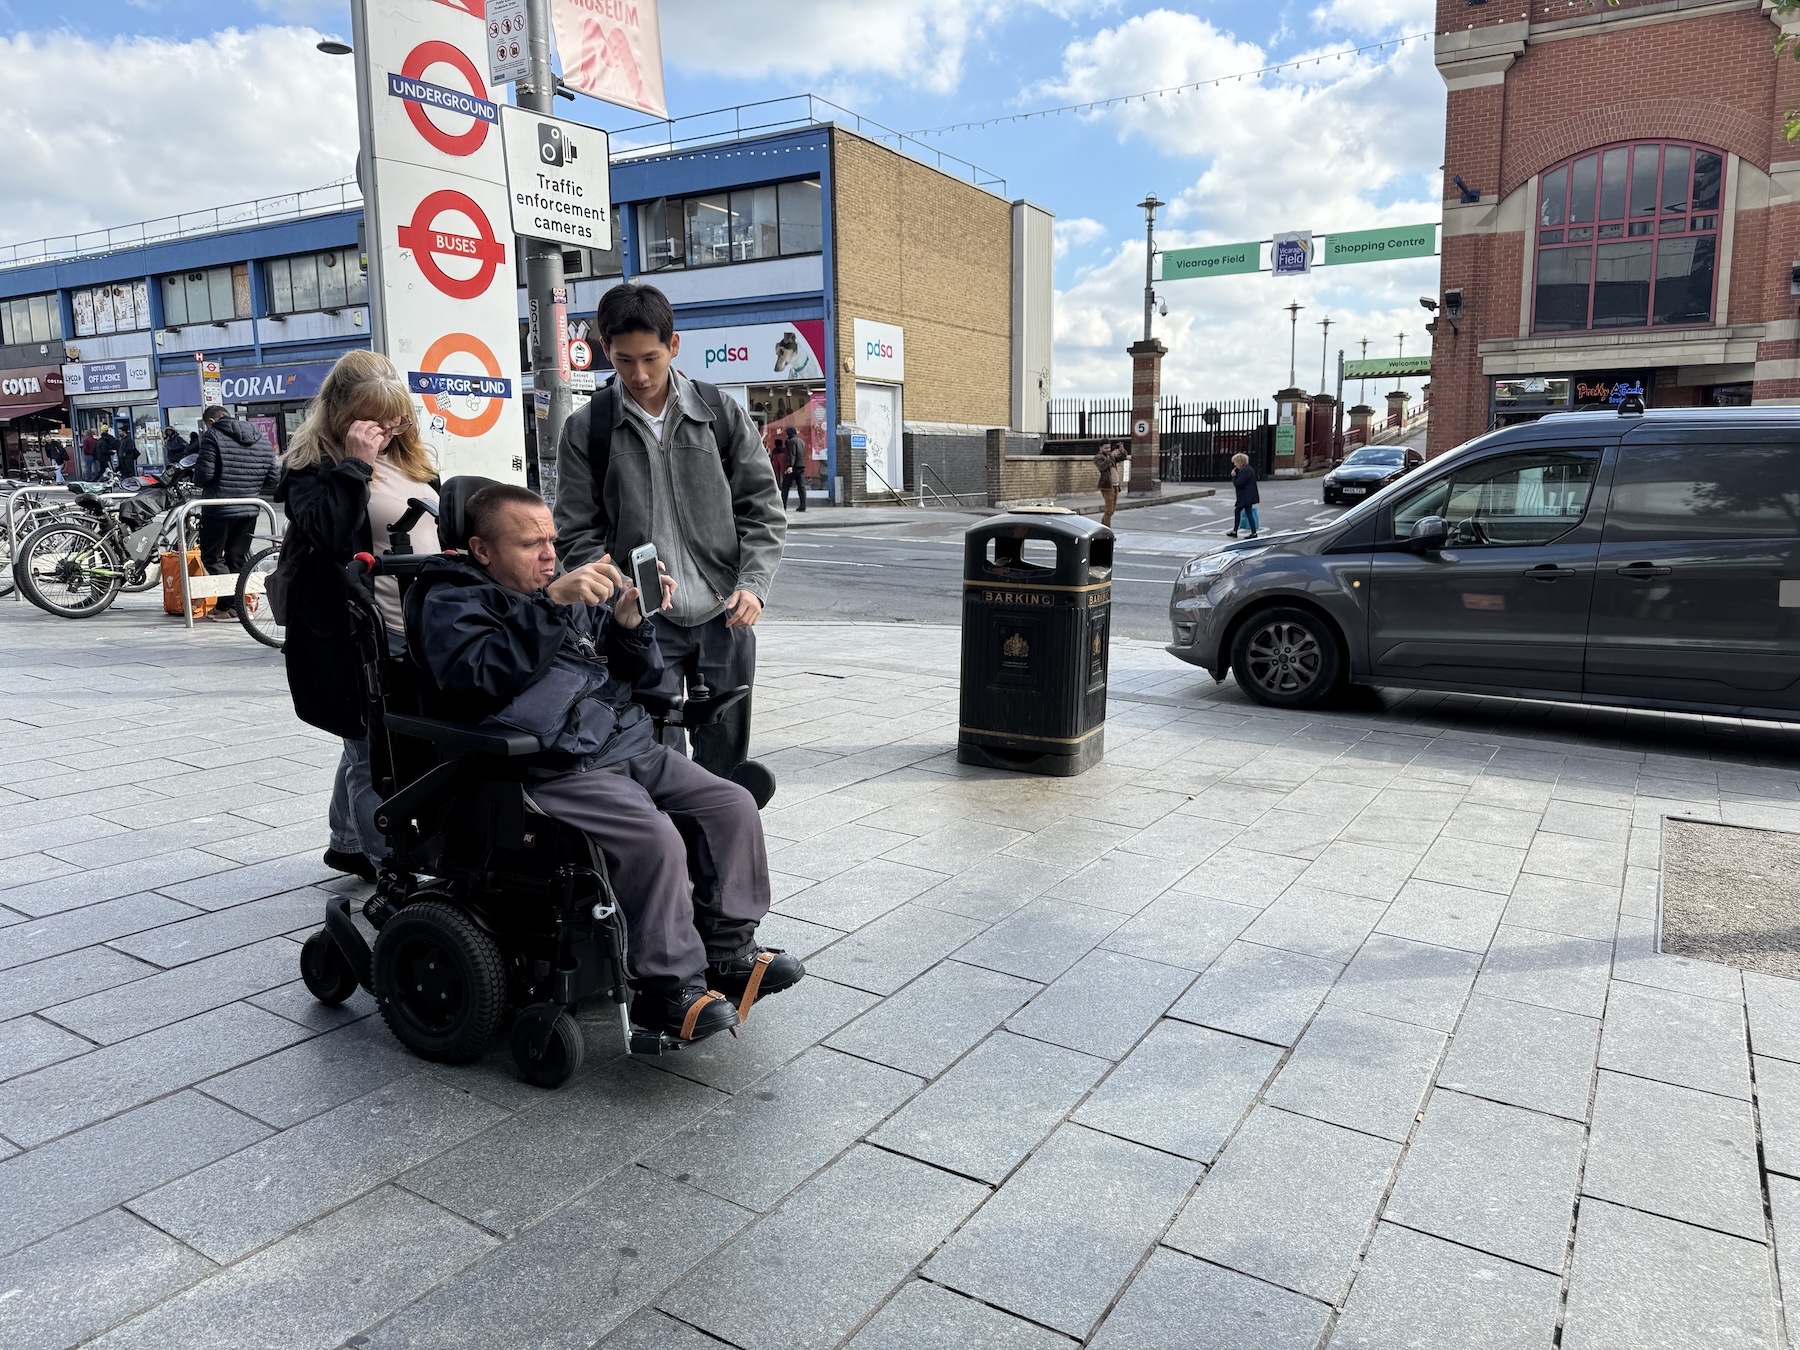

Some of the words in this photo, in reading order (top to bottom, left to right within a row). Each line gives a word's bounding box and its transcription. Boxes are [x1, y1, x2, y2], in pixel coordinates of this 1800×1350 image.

[392, 79, 495, 119] UNDERGROUND
[536, 172, 583, 197] Traffic
[516, 193, 606, 222] enforcement
[534, 216, 592, 238] cameras
[436, 234, 477, 254] BUSES
[1334, 241, 1385, 254] Shopping
[1387, 238, 1426, 248] Centre
[1176, 258, 1220, 269] Vicarage
[1222, 254, 1245, 264] Field
[1279, 252, 1304, 265] Field
[705, 343, 749, 369] pdsa
[866, 339, 893, 360] pdsa
[2, 377, 42, 397] COSTA
[88, 374, 99, 384] OFF
[99, 373, 121, 383] LICENCE
[221, 374, 287, 398] CORAL
[419, 377, 506, 394] VERGRUND
[1138, 423, 1146, 433] 5
[985, 591, 1051, 605] BARKING
